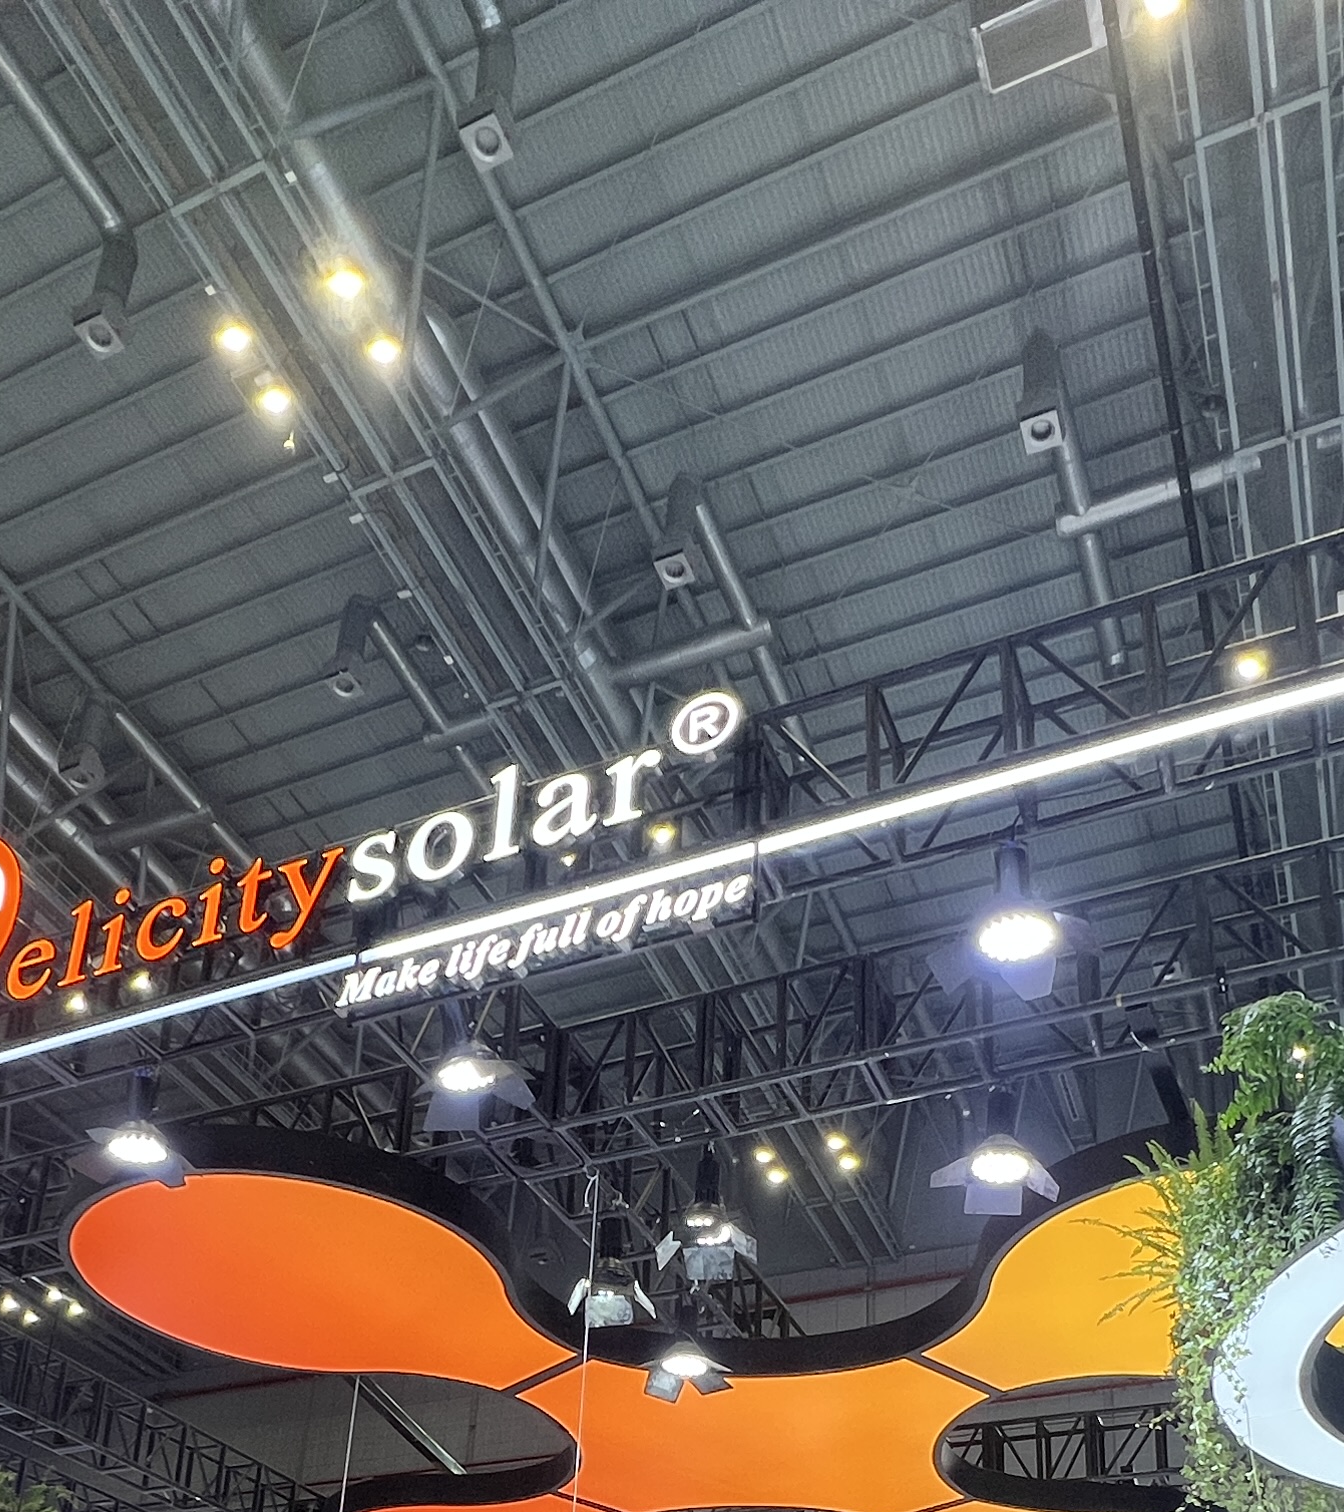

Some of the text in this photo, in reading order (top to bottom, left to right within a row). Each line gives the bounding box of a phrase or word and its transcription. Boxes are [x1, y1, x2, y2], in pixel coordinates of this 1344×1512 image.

[335, 873, 753, 1008] Make life full of hope
